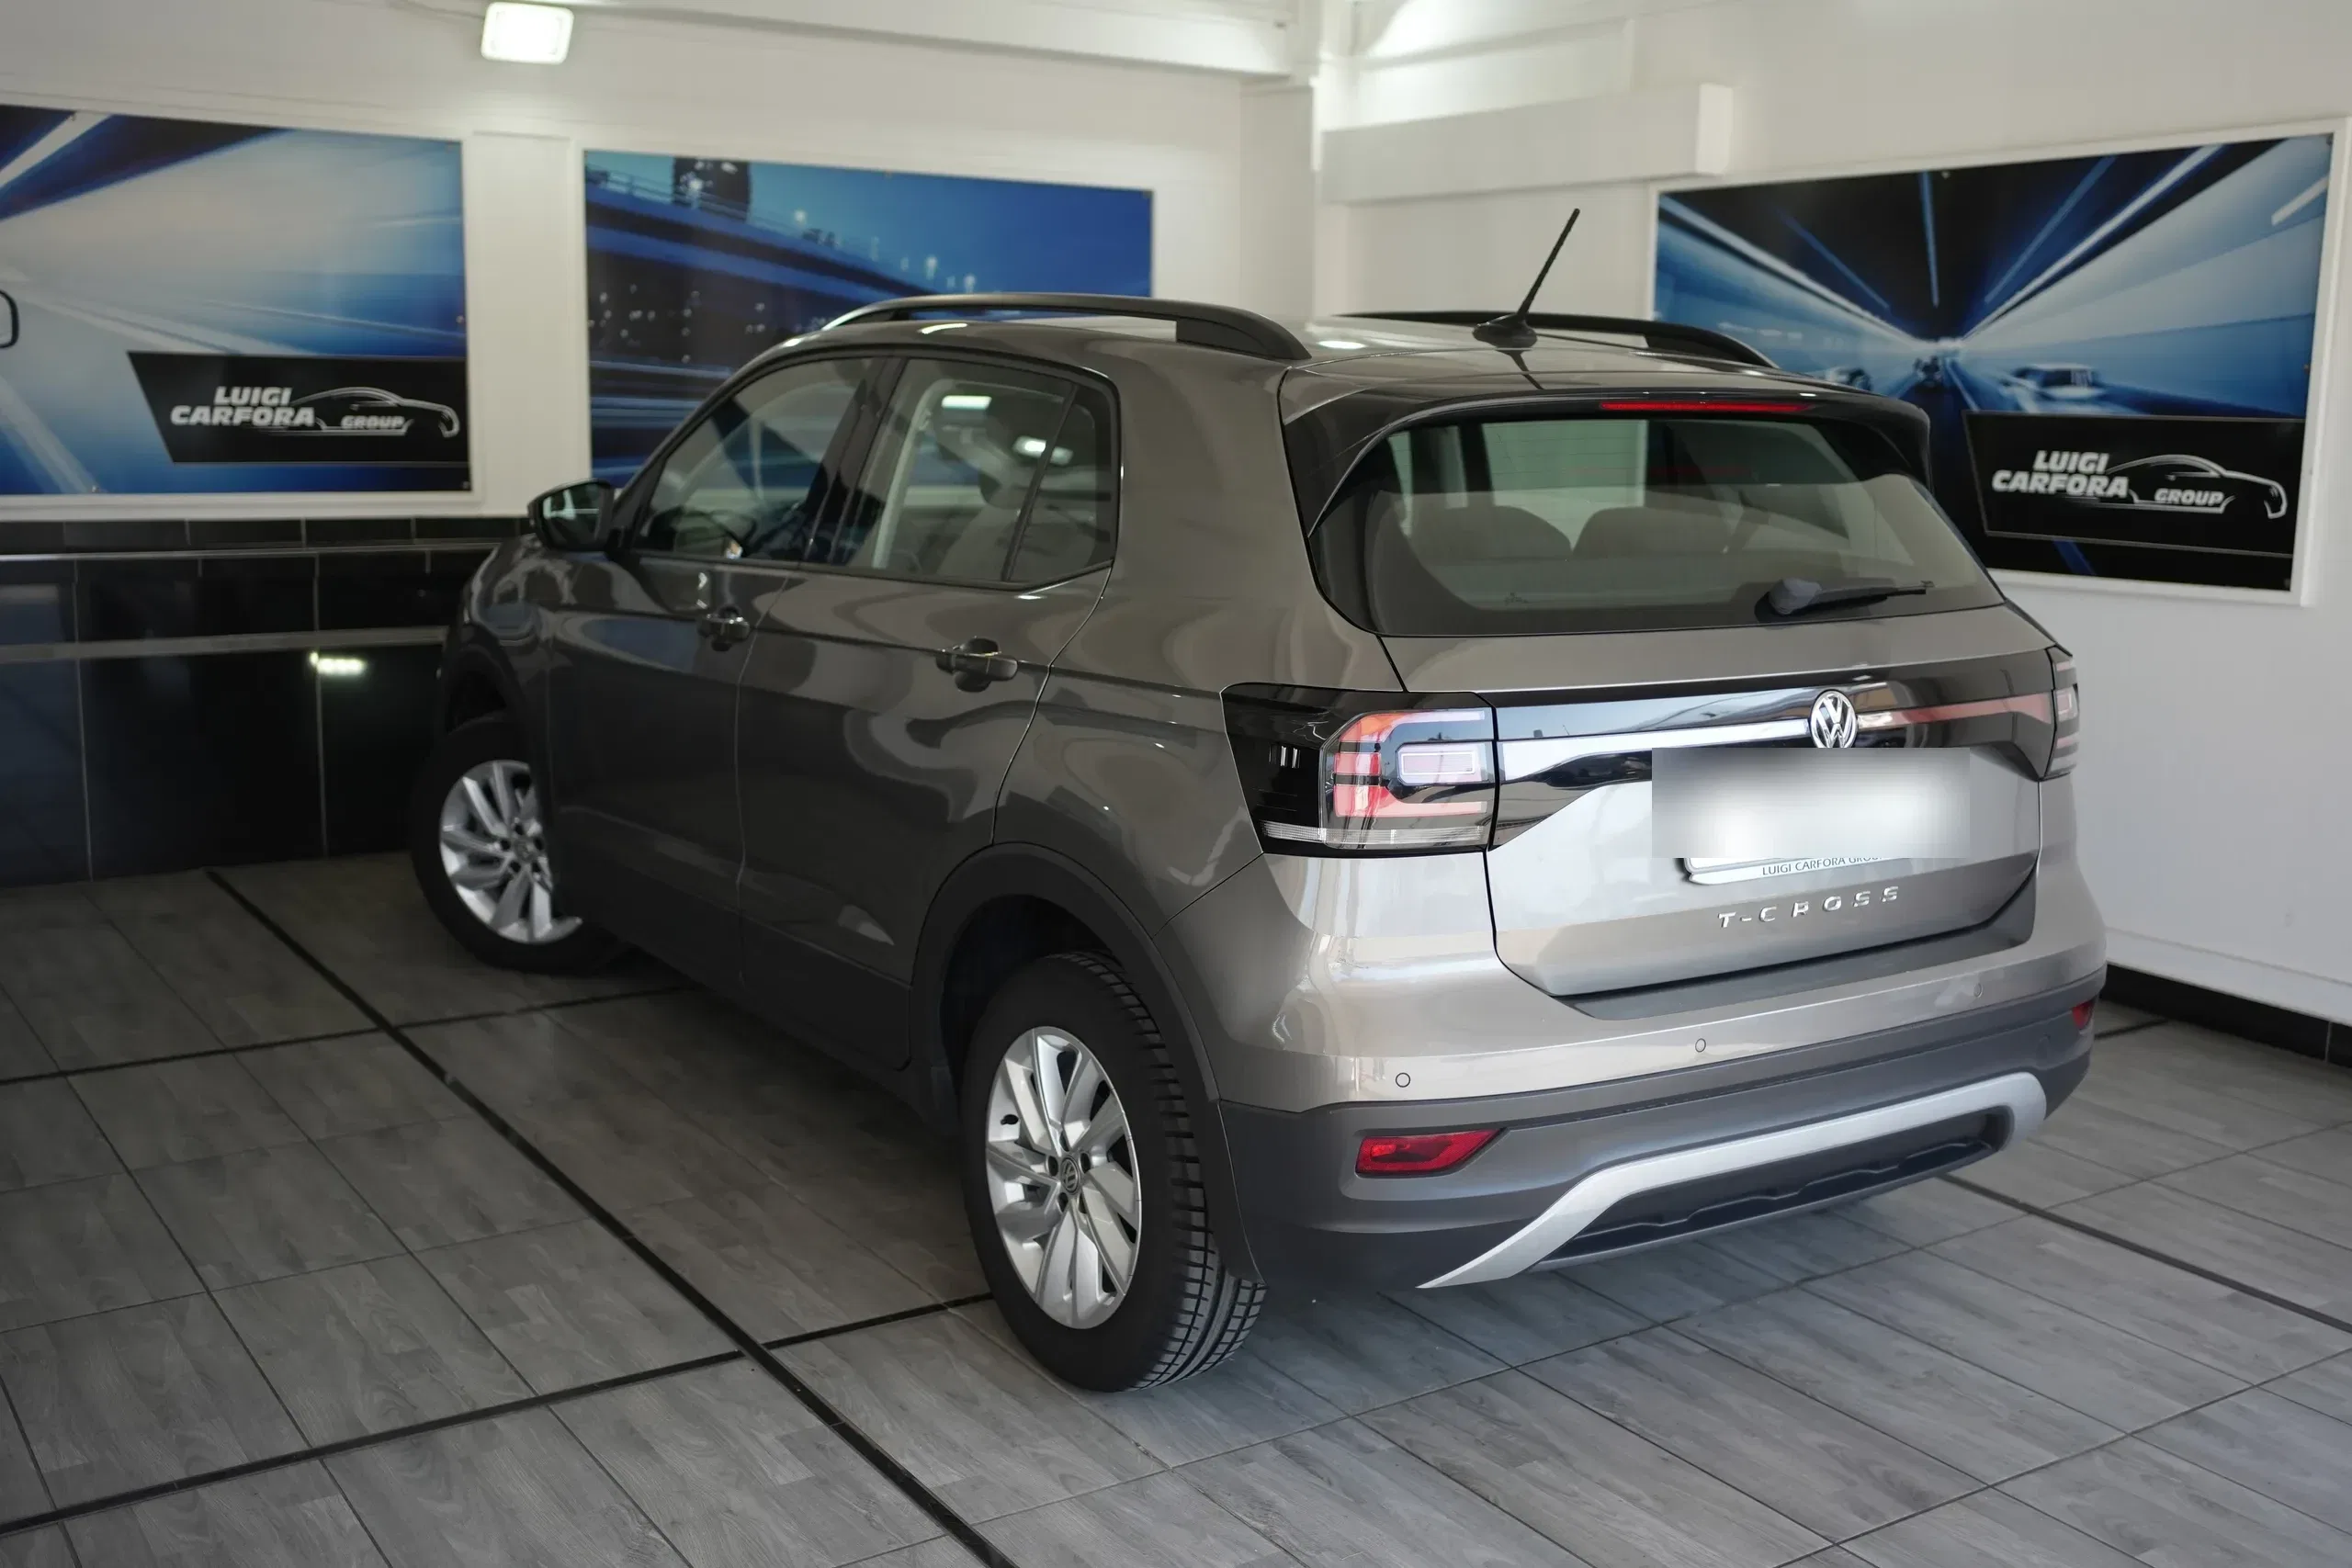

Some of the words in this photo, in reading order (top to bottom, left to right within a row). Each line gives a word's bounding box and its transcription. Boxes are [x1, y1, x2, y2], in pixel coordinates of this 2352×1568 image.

[213, 386, 293, 407] LUIGI
[170, 405, 315, 427] CARFORA
[340, 414, 405, 430] GROUP
[2033, 450, 2109, 474] LUIGI
[1992, 469, 2129, 499] CARFORA
[2154, 488, 2224, 506] GROUP
[1762, 863, 1792, 875] LUIGI
[1795, 857, 1846, 872] CARFORA
[1718, 886, 1899, 928] T-CROSS
